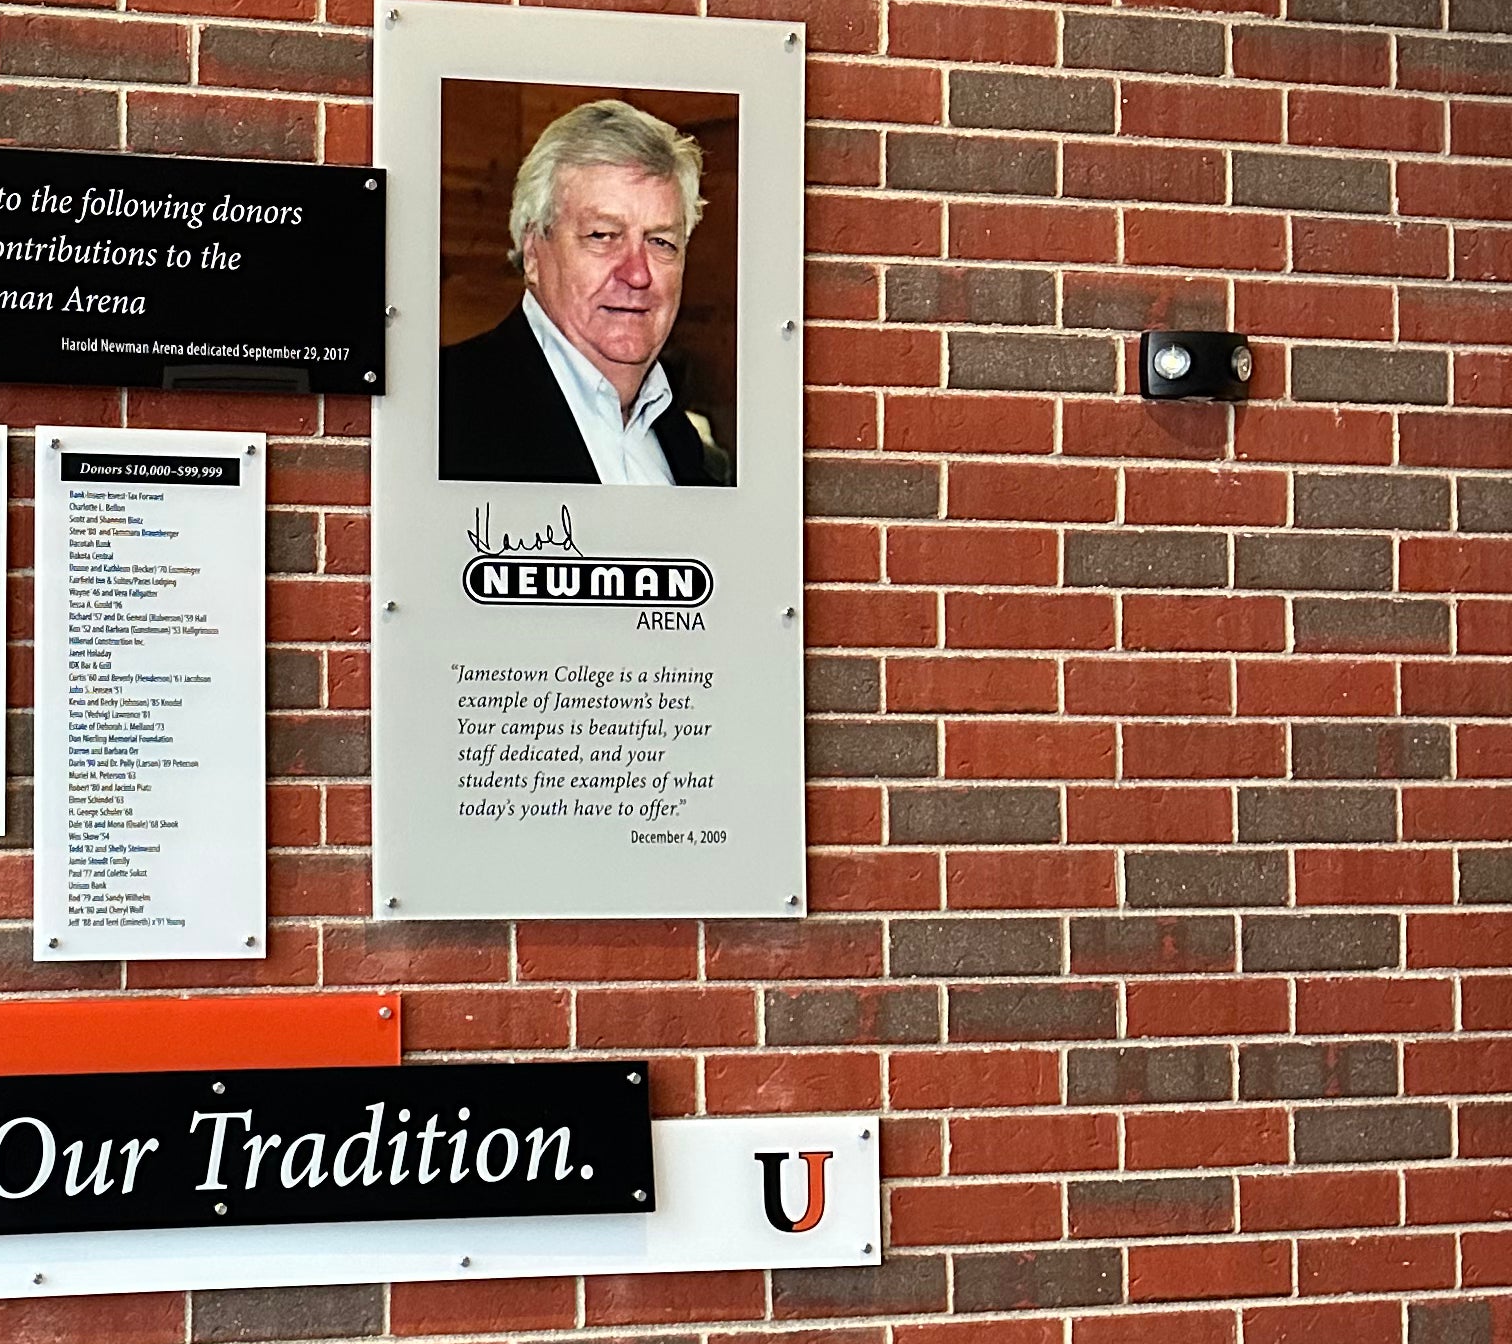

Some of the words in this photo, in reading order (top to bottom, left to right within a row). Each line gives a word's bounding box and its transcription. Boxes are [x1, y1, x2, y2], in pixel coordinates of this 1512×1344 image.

[31, 185, 72, 213] the
[74, 187, 206, 229] following
[212, 194, 302, 224] donors
[166, 244, 191, 267] to
[201, 242, 241, 270] the
[61, 286, 145, 314] Arena
[61, 337, 97, 351] Harold
[101, 338, 149, 353] Newman
[152, 340, 183, 354] Arena
[186, 342, 239, 356] dedicated
[242, 344, 301, 360] September
[303, 346, 320, 361] 29,
[323, 347, 349, 360] 2017
[80, 462, 122, 474] Donors
[483, 566, 693, 598] NEWMAN
[636, 611, 705, 631] ARENA
[554, 665, 614, 688] College
[619, 666, 632, 683] is
[638, 671, 647, 682] a
[653, 665, 713, 689] shining
[458, 690, 527, 713] example
[533, 691, 552, 714] of
[658, 692, 694, 709] best.
[457, 718, 496, 734] Your
[501, 721, 564, 740] campus
[570, 719, 582, 735] is
[588, 718, 666, 740] beautiful,
[672, 724, 712, 741] your
[458, 743, 497, 766] staff
[499, 744, 583, 764] dedicated,
[590, 744, 622, 761] and
[625, 750, 666, 767] your
[458, 770, 528, 788] students
[529, 770, 565, 793] fine
[570, 771, 646, 793] examples
[652, 771, 670, 793] of
[673, 771, 714, 788] what
[459, 798, 515, 821] today’s
[518, 798, 567, 821] youth
[573, 798, 612, 816] have
[618, 801, 633, 816] to
[631, 830, 684, 844] December
[686, 830, 697, 845] 4,
[700, 830, 726, 843] 2009
[93, 868, 105, 877] and
[189, 1102, 593, 1188] Tradition.
